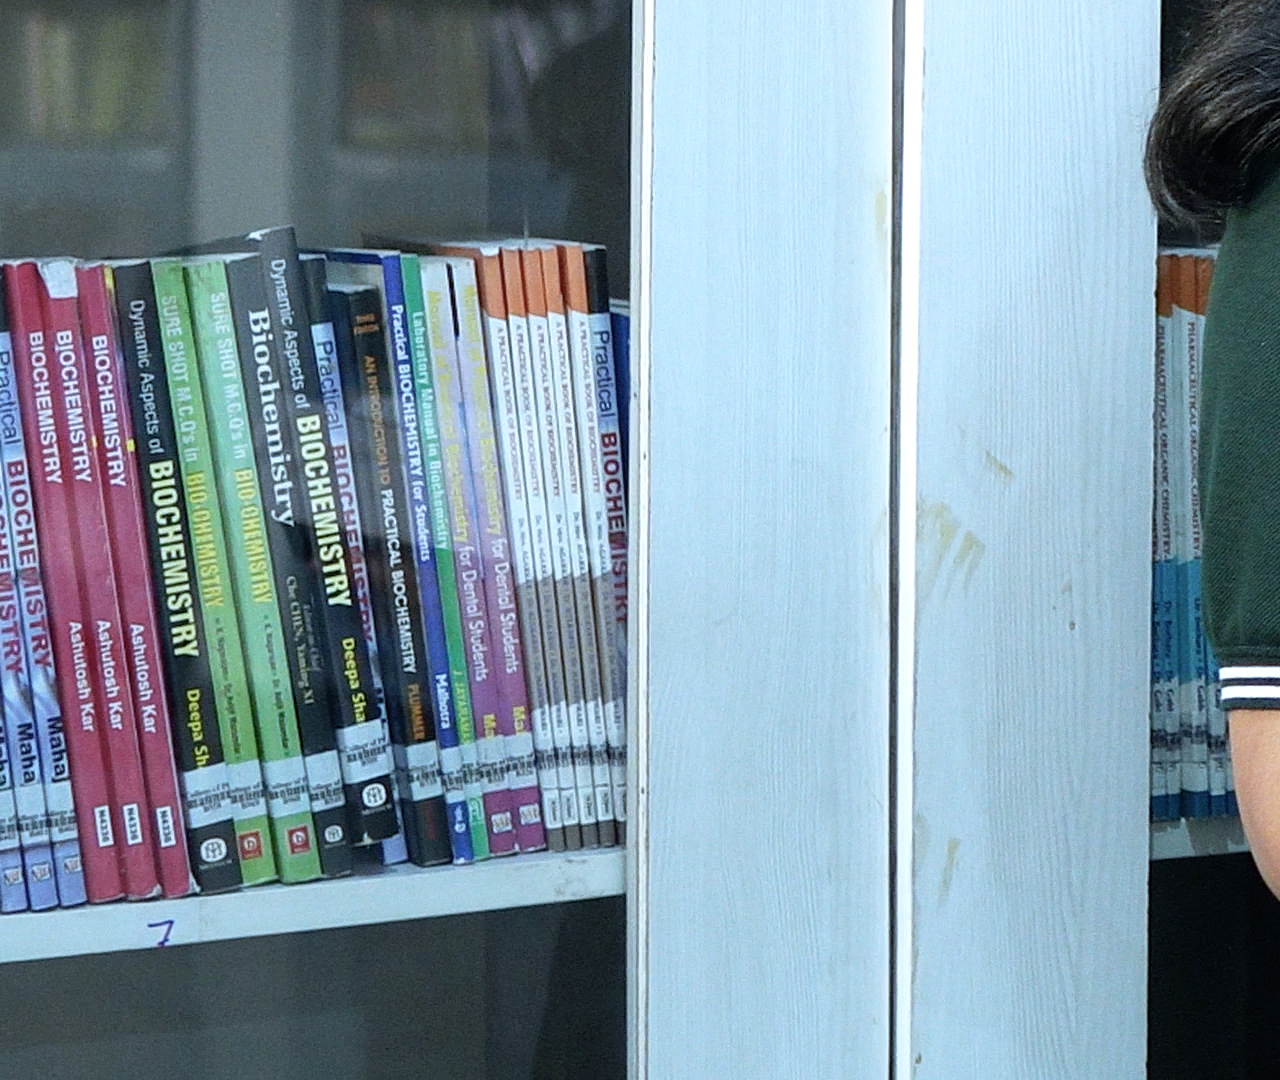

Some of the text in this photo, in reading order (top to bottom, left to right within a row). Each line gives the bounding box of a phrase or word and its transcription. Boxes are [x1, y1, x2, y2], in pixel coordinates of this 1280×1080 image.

[160, 296, 179, 336] SURE
[209, 292, 228, 333] SURE
[270, 259, 295, 326] Dynamic
[169, 342, 188, 382] SHOT
[216, 338, 234, 378] SHOT
[283, 330, 308, 391] Aspects
[317, 340, 343, 430] Practical
[593, 330, 615, 418] Practical
[247, 307, 295, 528] Biochemistry
[294, 393, 310, 410] of
[412, 312, 450, 550] Laboratory Manual in Biochemistry
[184, 448, 199, 462] in
[232, 445, 247, 459] in
[28, 331, 96, 733] BIOCHEMISTRY Ashutosh Kar
[55, 330, 125, 731] BIOCHEMISTRY Ashutosh Kar
[91, 335, 158, 734] BIOCHEMISTRY Ashutosh Kar
[128, 300, 209, 769] Dynamic Aspects of BIOCHEMISTRY Deepa Sh
[296, 414, 352, 607] BIOCHEMISTRY
[381, 490, 405, 567] PRACTICAL
[391, 304, 451, 729] Practical BIOCHEMISTRY for Students Malhotra
[7, 460, 52, 668] BIOCHEMISTRY
[458, 546, 474, 567] for
[491, 538, 508, 559] for
[461, 570, 480, 617] Dental
[494, 563, 514, 610] Dental
[390, 571, 417, 674] BIOCHEMISTRY
[467, 621, 488, 682] Students
[499, 613, 520, 674] Students
[341, 637, 365, 690] Deepa
[408, 683, 425, 740] PLUMMER
[147, 920, 175, 948] 7
